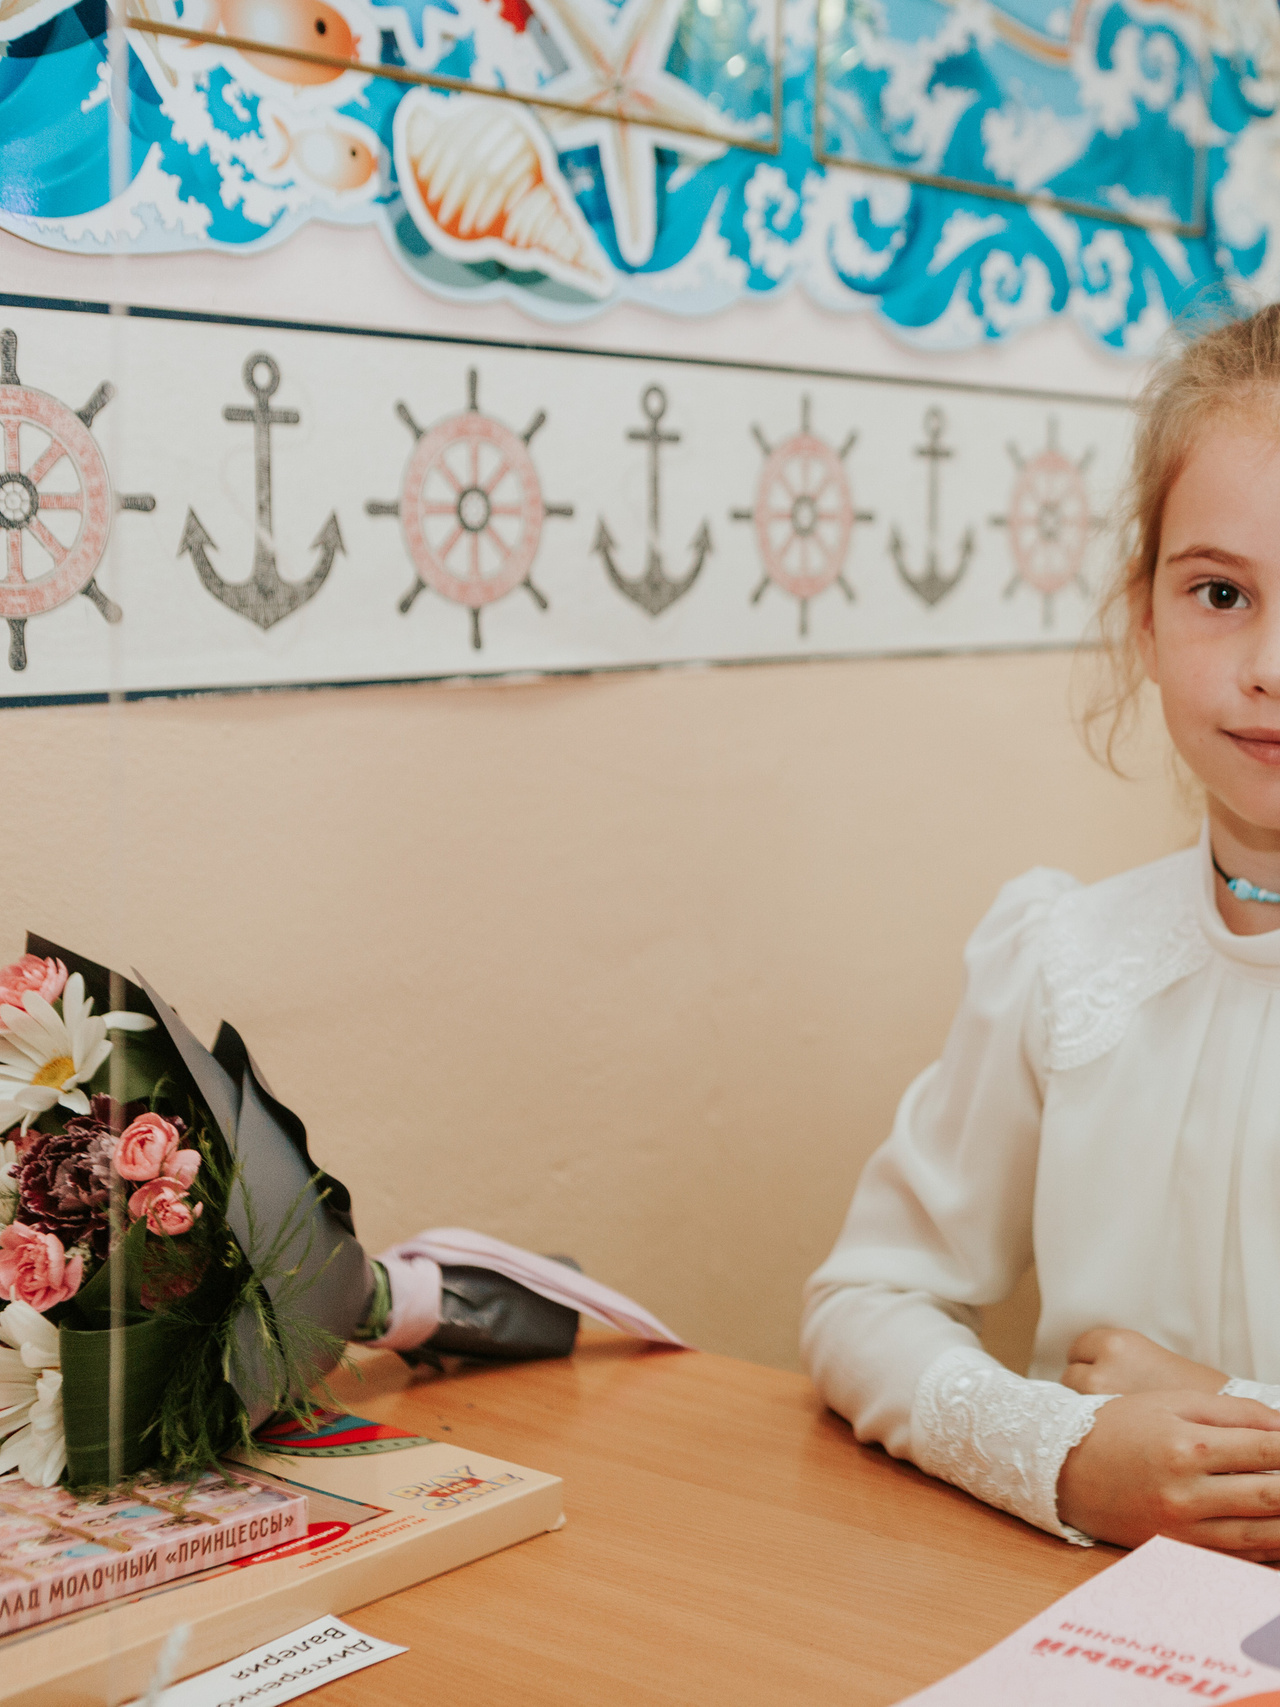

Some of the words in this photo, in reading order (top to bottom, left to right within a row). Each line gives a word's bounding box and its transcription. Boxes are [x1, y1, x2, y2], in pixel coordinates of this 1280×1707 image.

[387, 1465, 477, 1500] PLAY
[422, 1472, 525, 1511] GAME
[49, 1549, 158, 1603] МОЛОЧНЫЙ
[165, 1513, 294, 1564] «ПРИНЦЕССЫ»
[231, 1627, 347, 1681] Валерия
[1059, 1621, 1196, 1664] обучения
[1031, 1638, 1229, 1698] Первый
[1201, 1657, 1251, 1678] год
